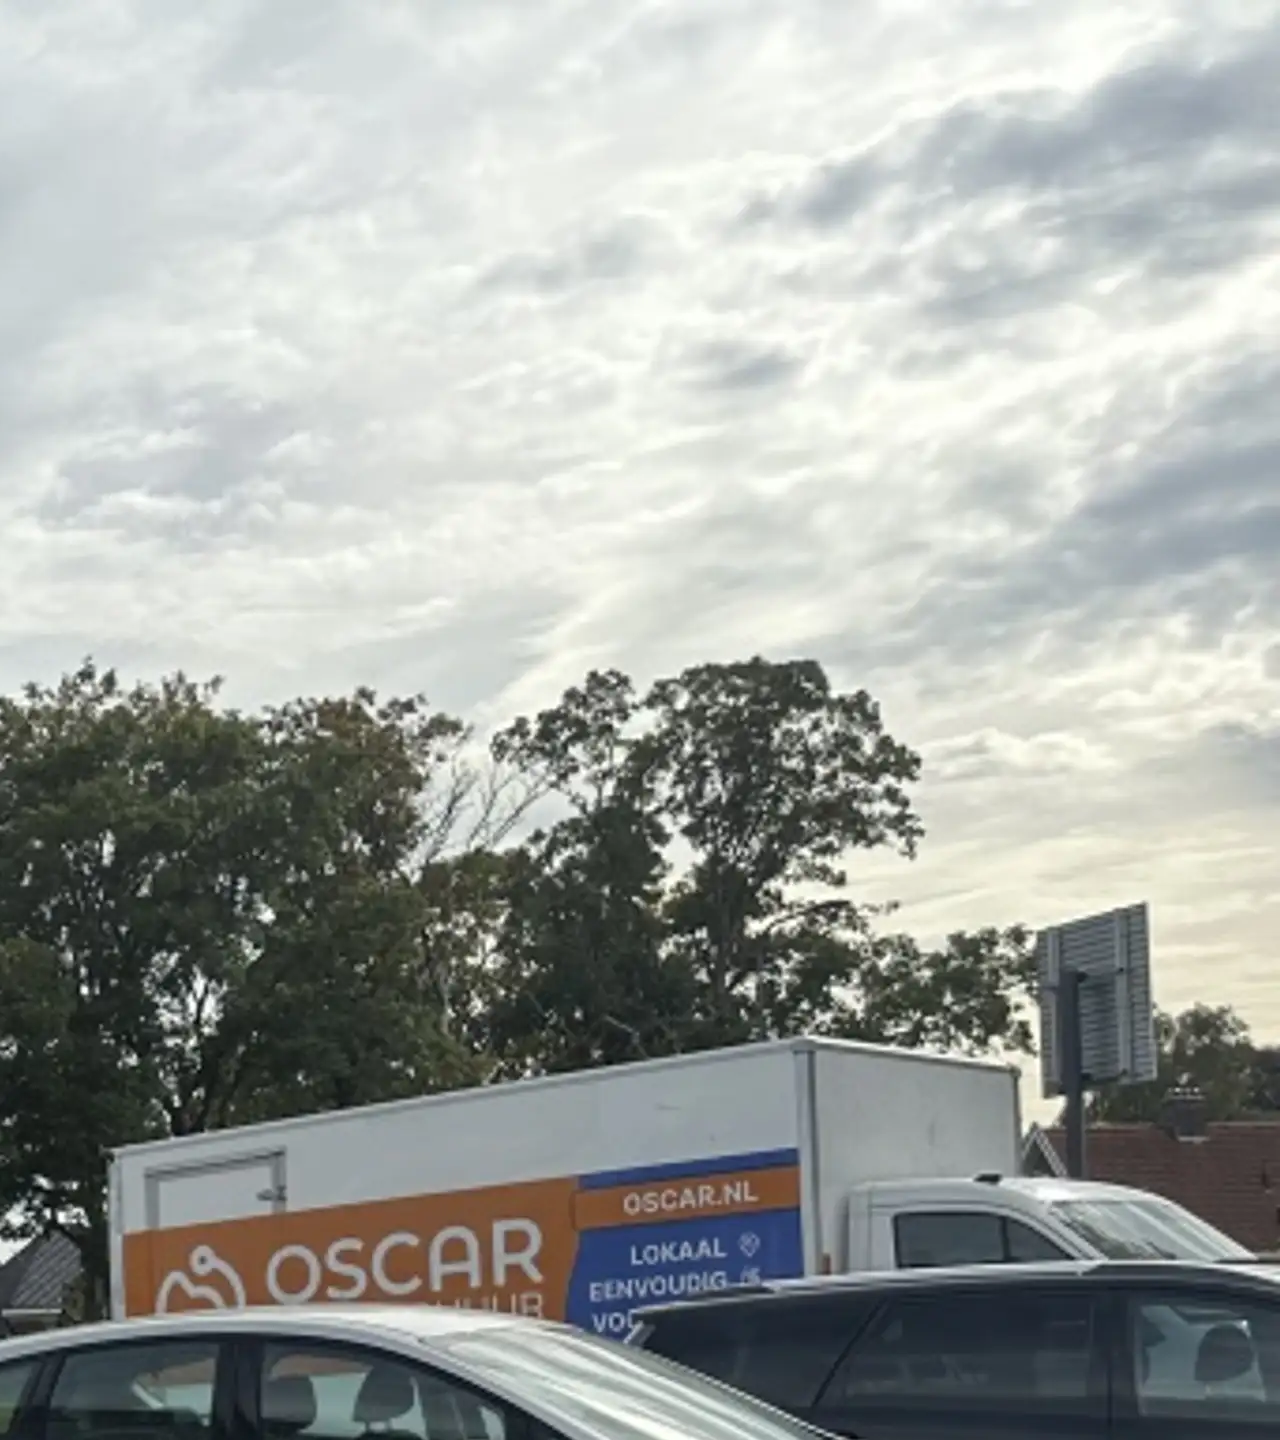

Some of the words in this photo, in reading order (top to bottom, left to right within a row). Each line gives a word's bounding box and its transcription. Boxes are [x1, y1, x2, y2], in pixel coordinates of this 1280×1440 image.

[622, 1179, 759, 1216] OSCAR.NL
[266, 1217, 545, 1305] OSCAR
[630, 1236, 728, 1267] LOKAAL
[588, 1269, 728, 1303] EENVOUDIG
